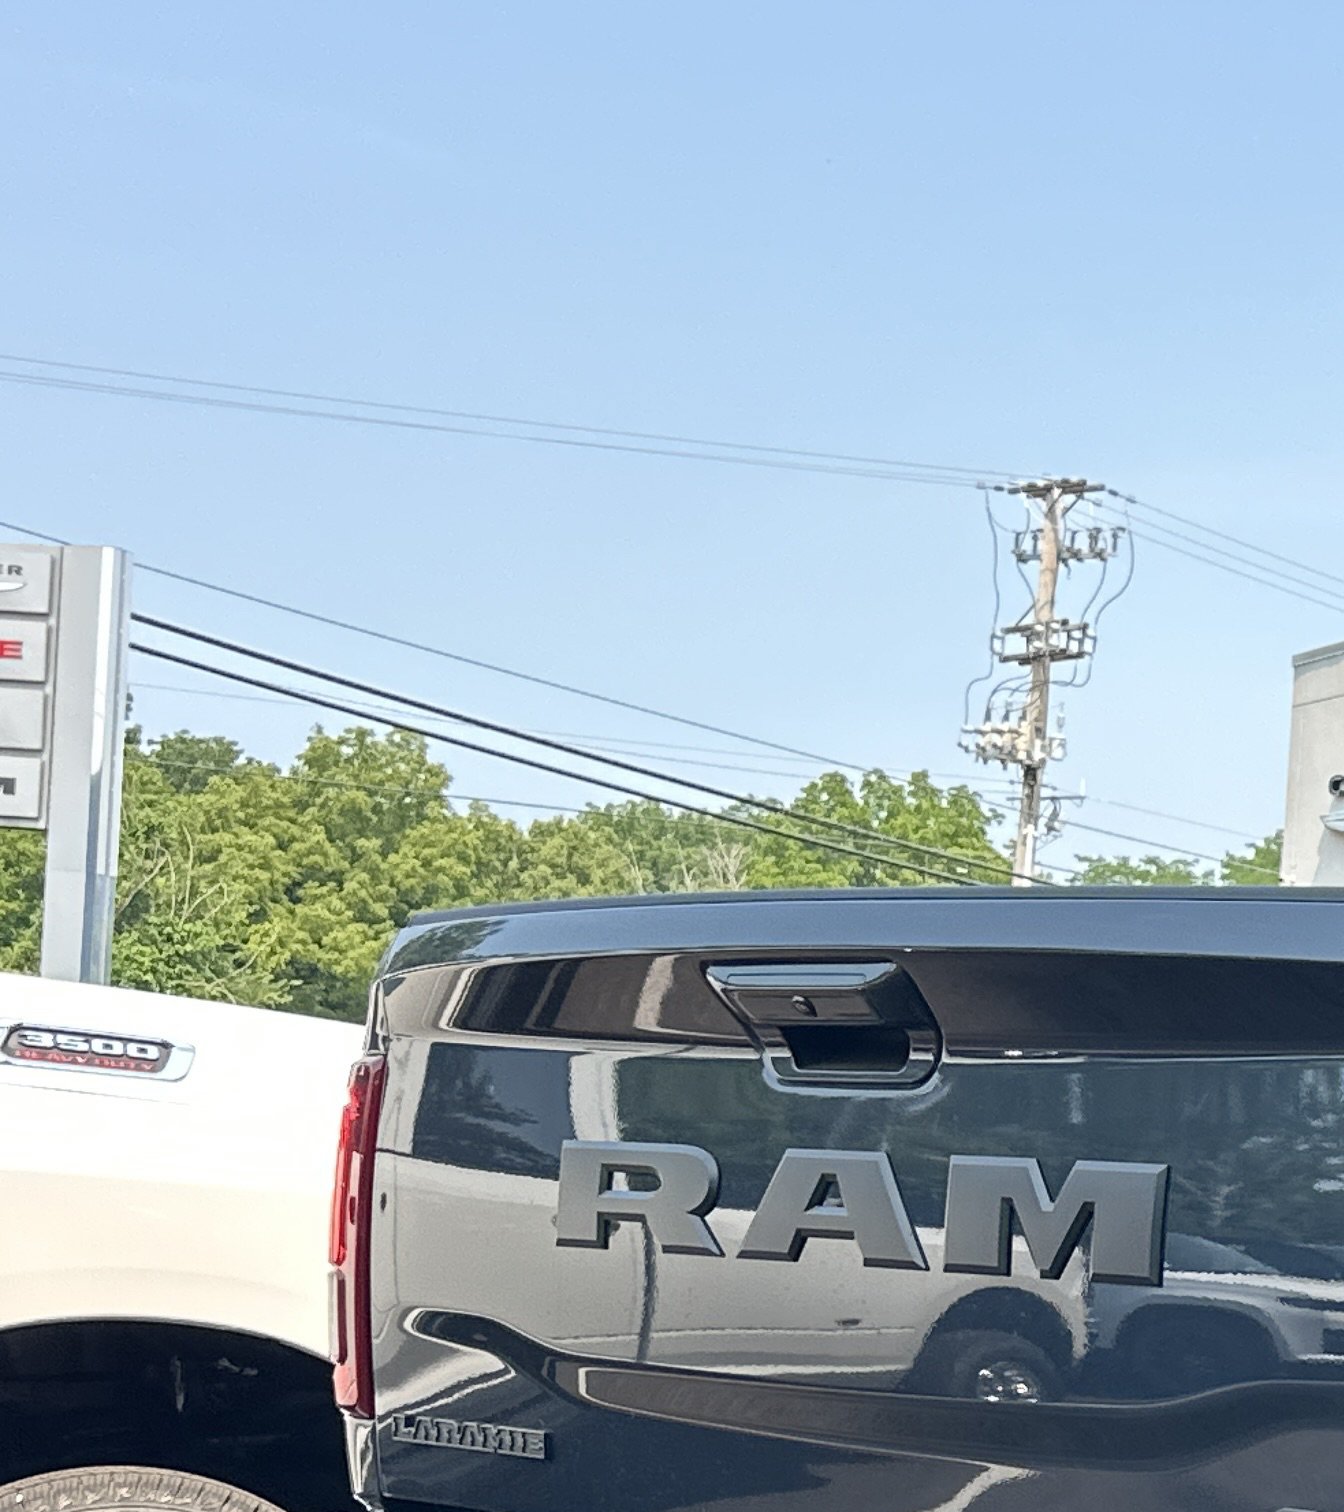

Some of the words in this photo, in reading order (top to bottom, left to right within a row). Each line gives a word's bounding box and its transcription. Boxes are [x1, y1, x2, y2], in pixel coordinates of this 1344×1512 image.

[17, 1031, 160, 1062] 3500
[555, 1139, 1171, 1287] RAM
[392, 1413, 546, 1460] LARAMIE
